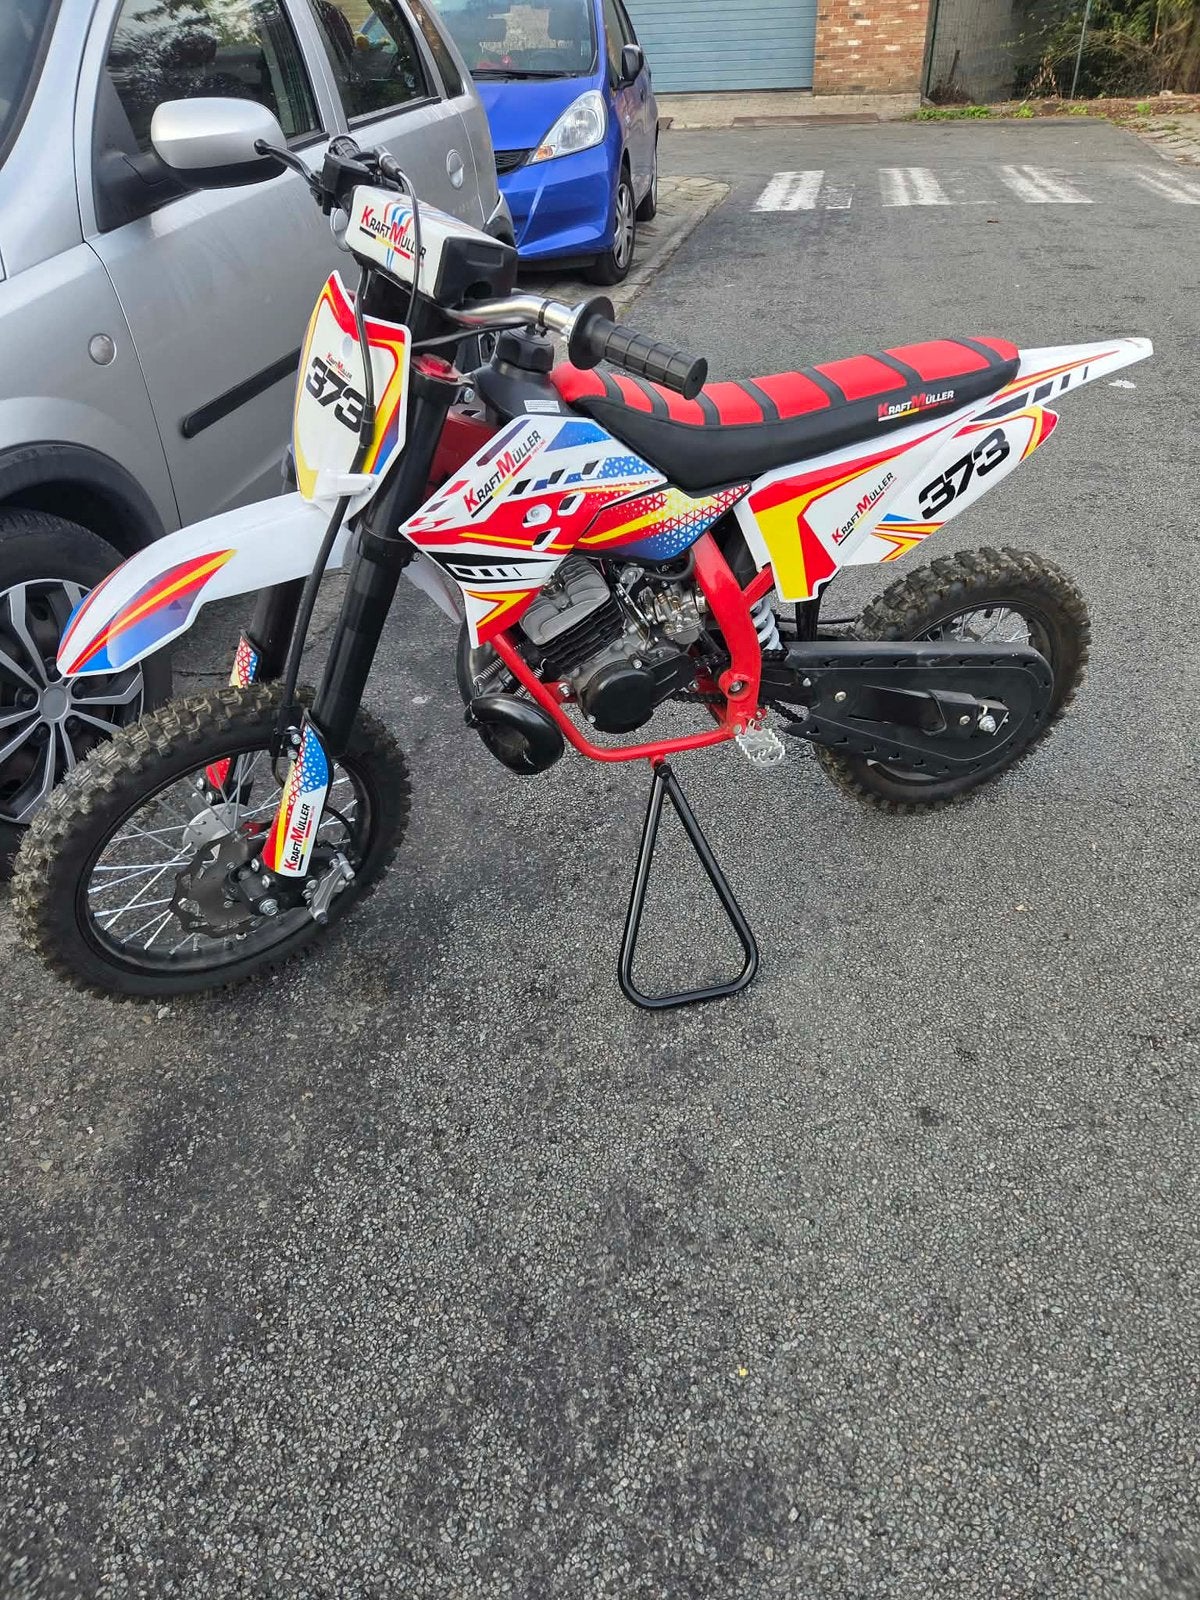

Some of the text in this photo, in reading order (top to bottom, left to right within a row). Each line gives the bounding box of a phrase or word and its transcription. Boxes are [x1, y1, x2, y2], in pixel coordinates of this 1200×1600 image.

[305, 356, 367, 433] 373
[463, 430, 541, 513] KRAFTMÜLLER
[918, 428, 1010, 520] 373
